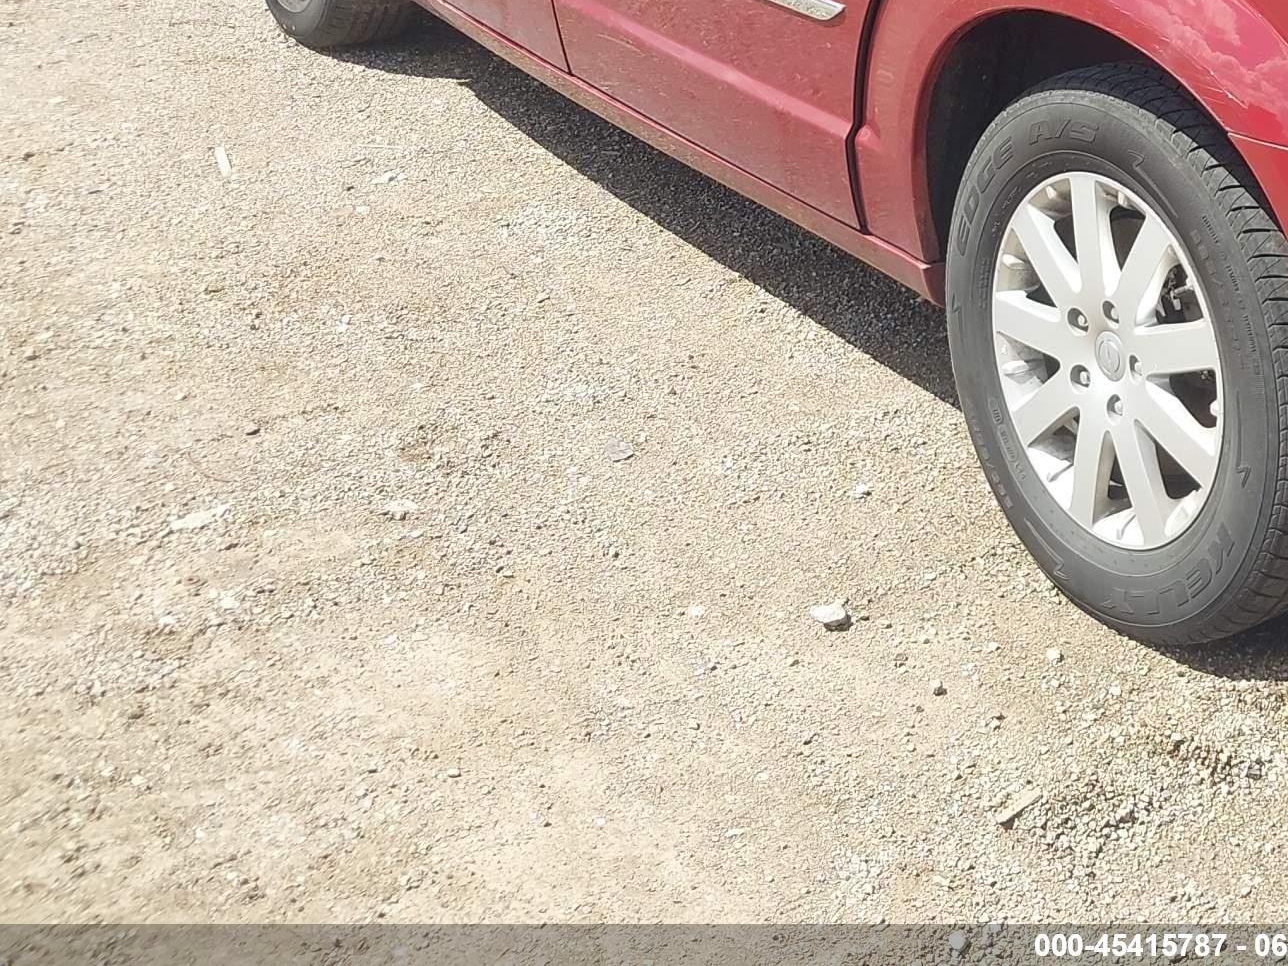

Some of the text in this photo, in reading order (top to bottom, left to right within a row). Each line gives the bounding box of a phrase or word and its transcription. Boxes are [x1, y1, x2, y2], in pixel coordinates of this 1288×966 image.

[956, 119, 1100, 257] EDGE A/S
[1101, 521, 1236, 616] KELLY
